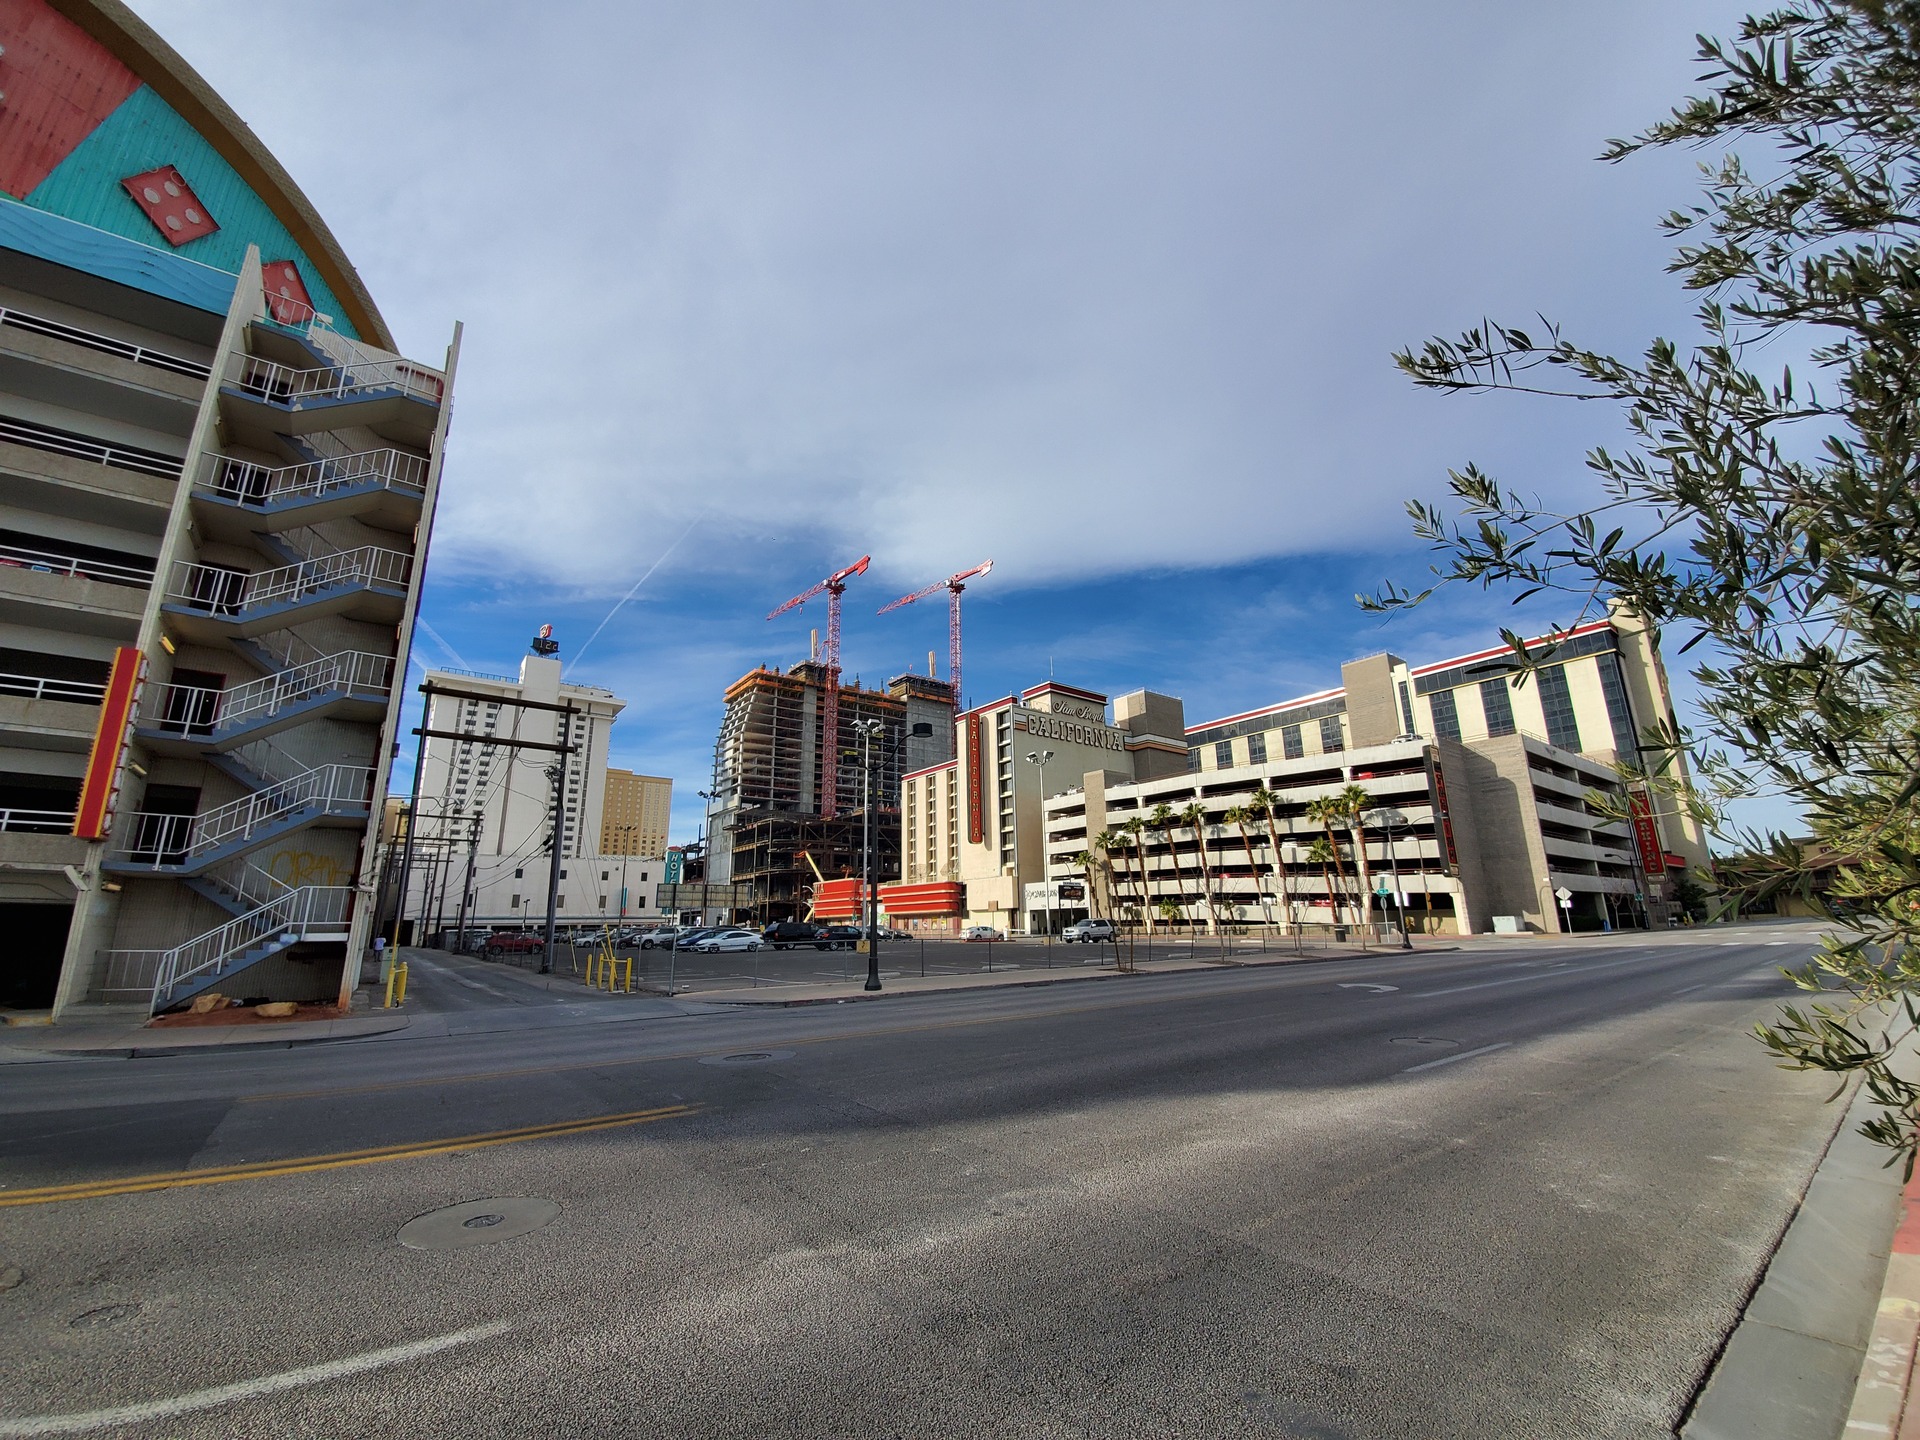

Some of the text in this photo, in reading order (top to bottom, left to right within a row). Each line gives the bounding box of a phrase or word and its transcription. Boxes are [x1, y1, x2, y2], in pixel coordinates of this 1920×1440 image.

[1027, 714, 1123, 751] CALIFORNIA
[1052, 700, 1076, 716] Sam
[971, 719, 980, 837] CALIFORNIA
[1635, 801, 1658, 871] ARKING
